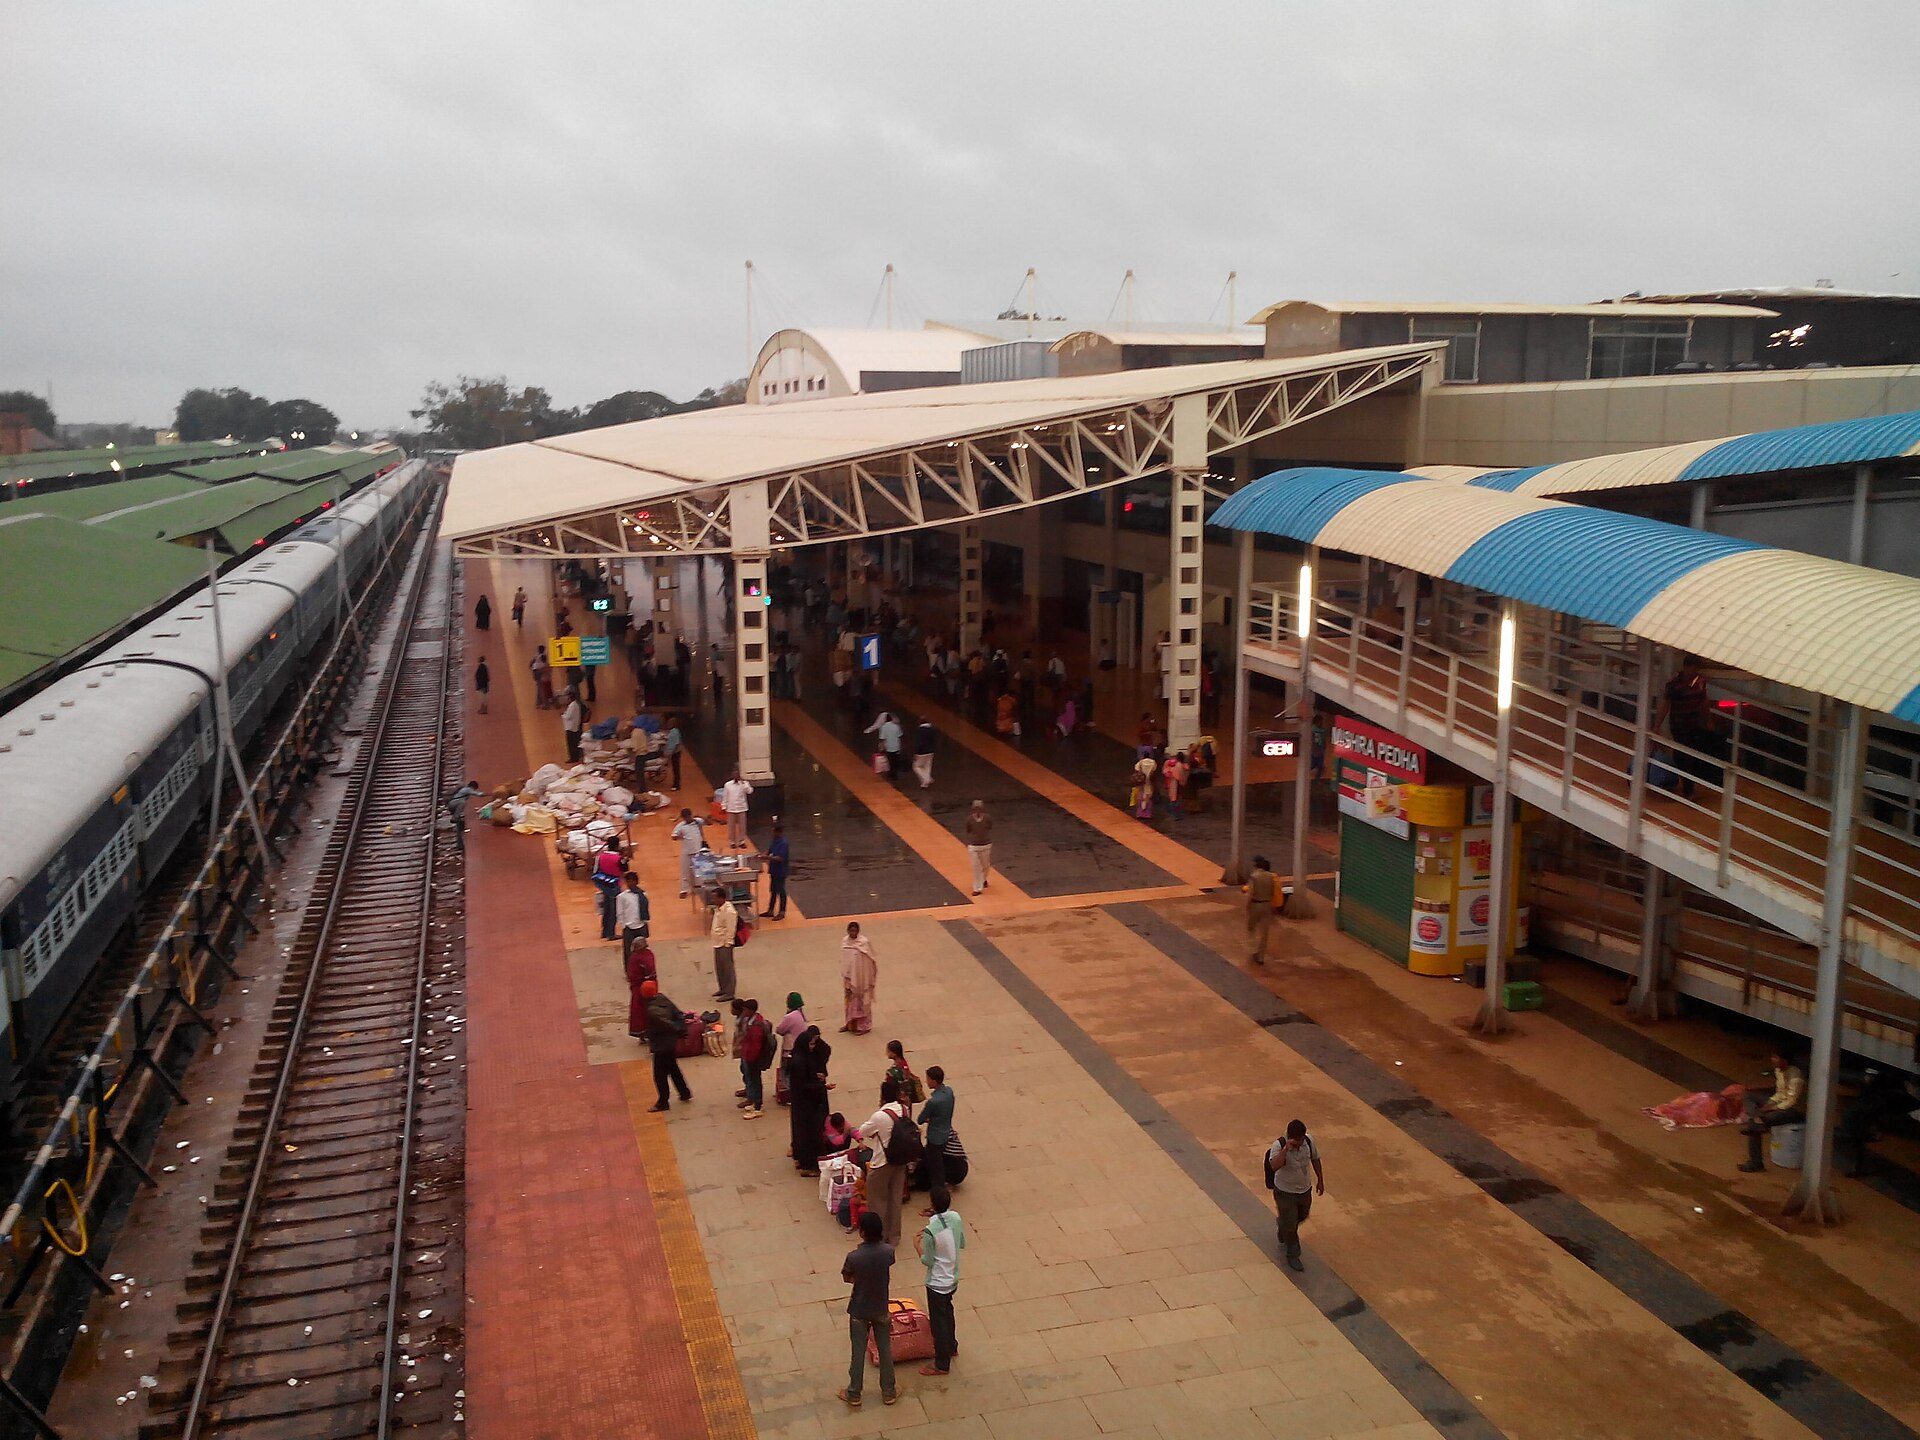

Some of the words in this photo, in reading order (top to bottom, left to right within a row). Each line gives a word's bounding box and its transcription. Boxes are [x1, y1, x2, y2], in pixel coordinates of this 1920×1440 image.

[555, 643, 565, 658] 1
[864, 638, 878, 666] 1
[1262, 742, 1294, 756] GEN
[1376, 741, 1420, 774] PEDHA
